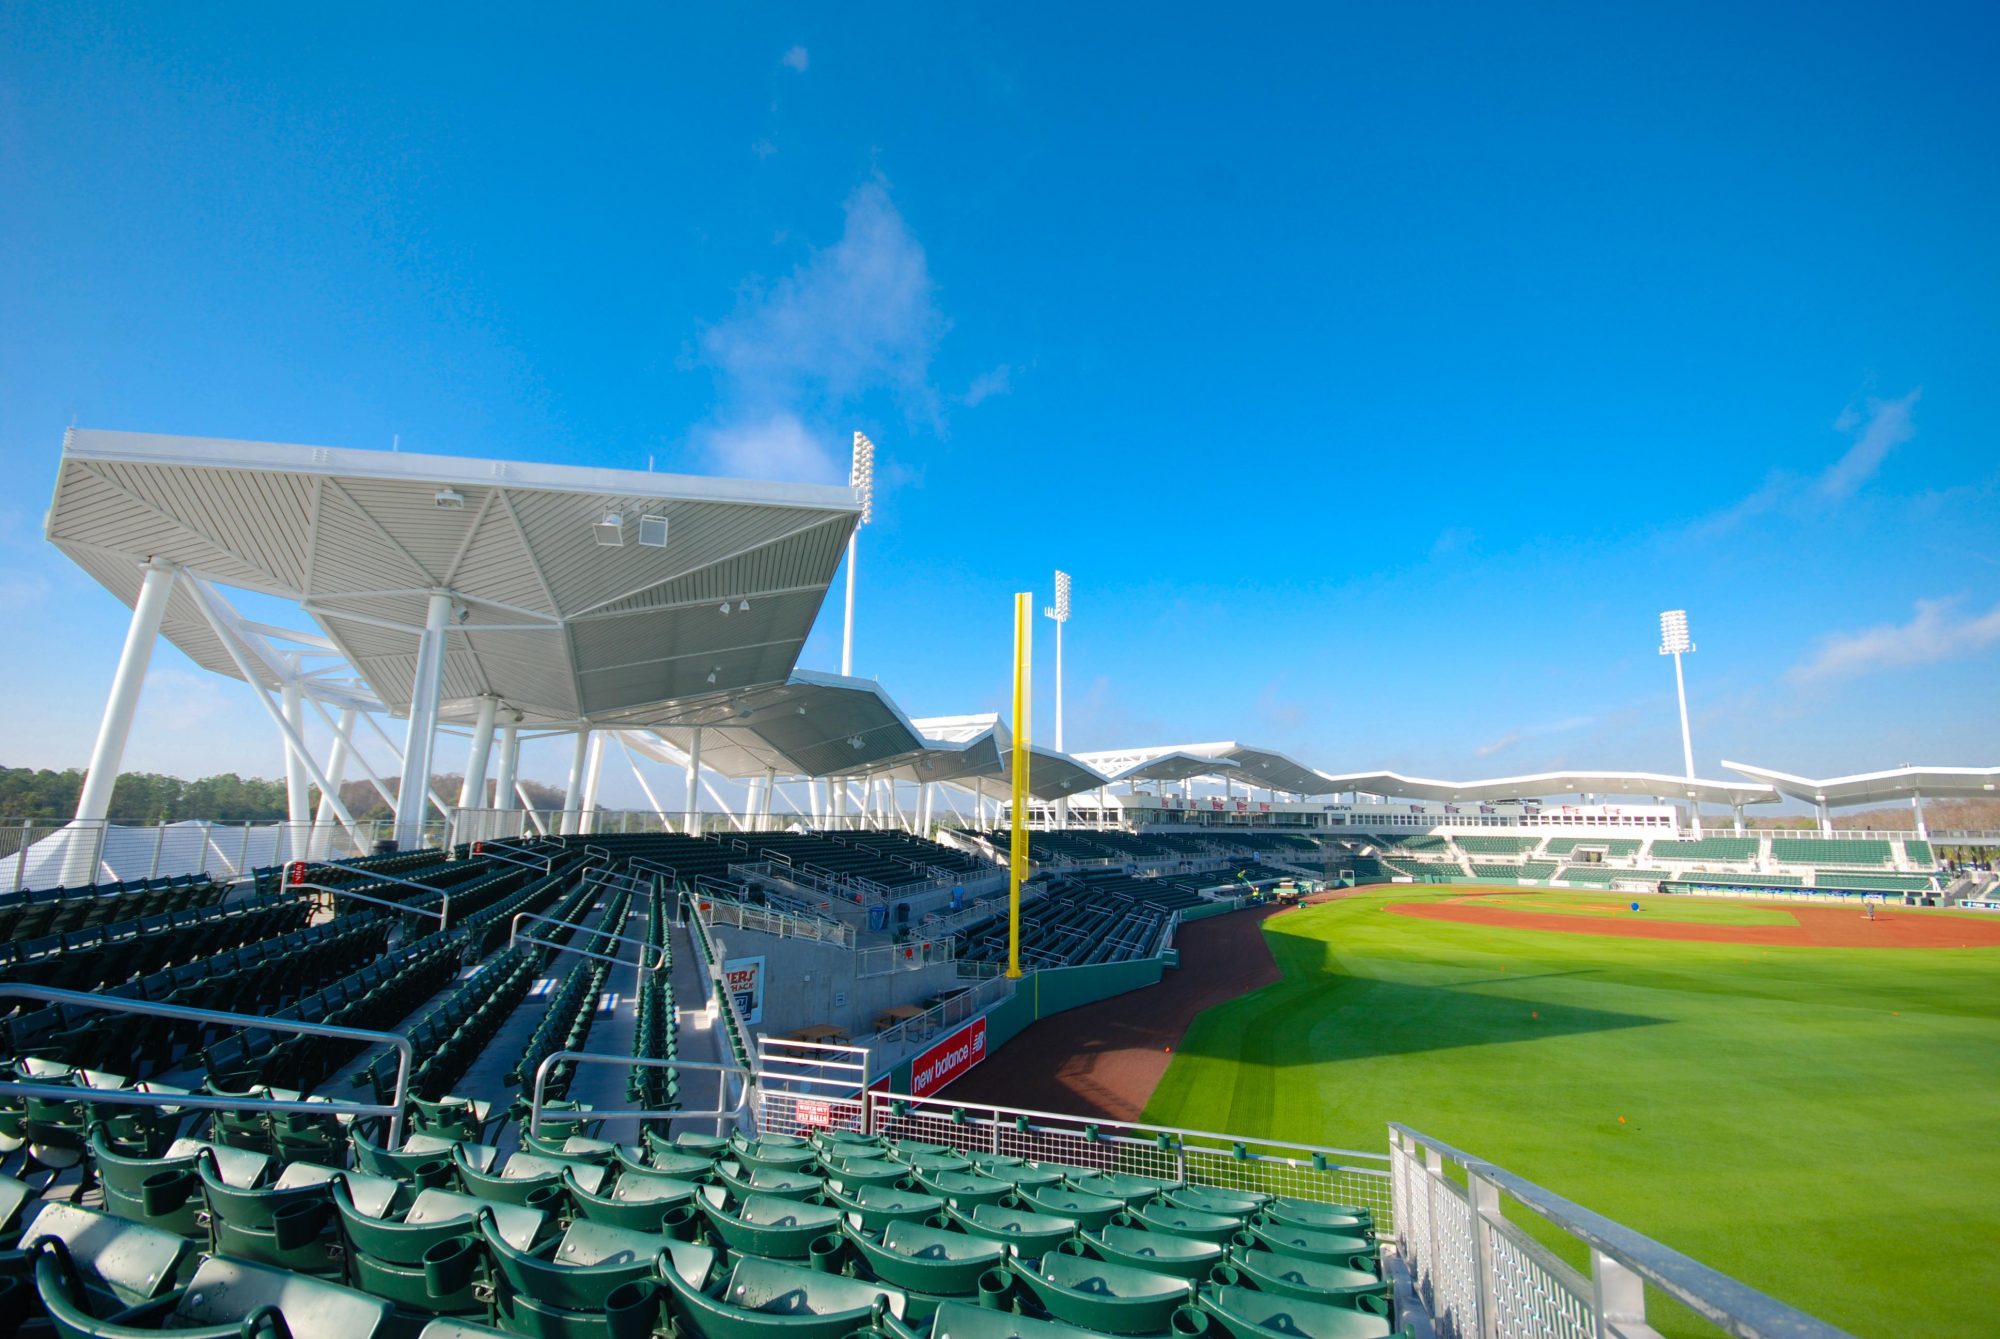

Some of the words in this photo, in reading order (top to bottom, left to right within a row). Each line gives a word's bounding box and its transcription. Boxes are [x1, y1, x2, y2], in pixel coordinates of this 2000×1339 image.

[913, 1065, 935, 1093] new
[935, 1044, 969, 1079] balance
[798, 1112, 808, 1121] FLY
[808, 1114, 828, 1123] BALLS
